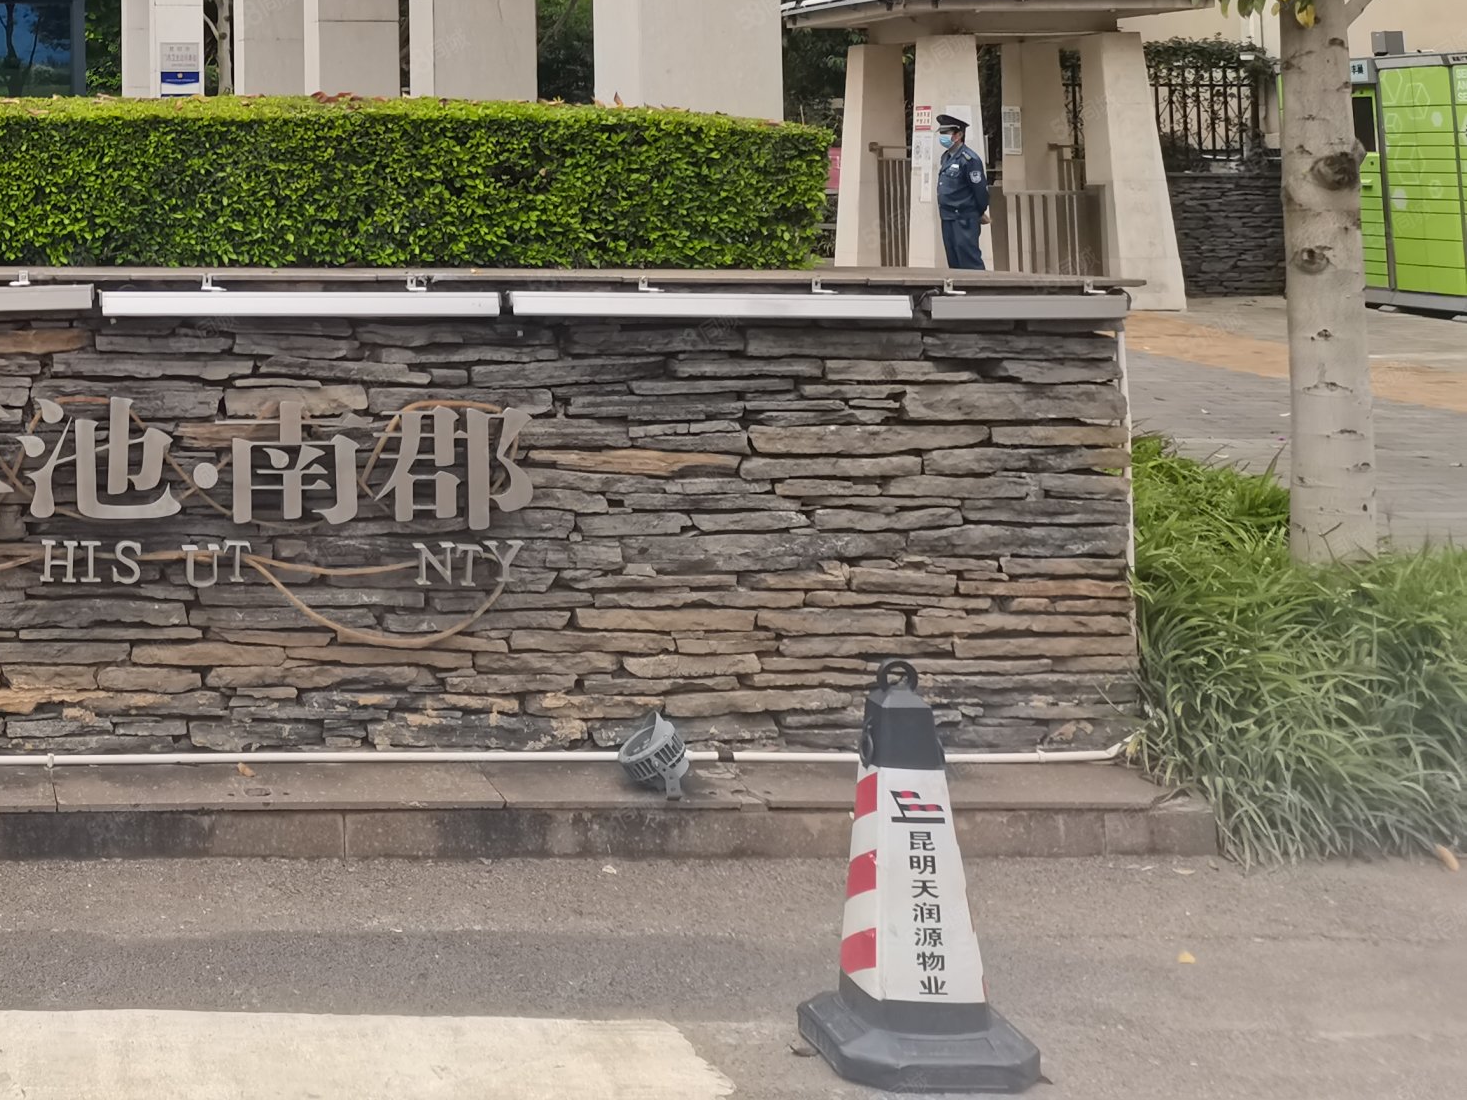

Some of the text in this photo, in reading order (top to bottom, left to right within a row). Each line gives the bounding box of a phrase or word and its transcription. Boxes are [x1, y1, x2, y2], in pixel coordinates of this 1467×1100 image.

[908, 830, 949, 996] 昆明天润源物业
